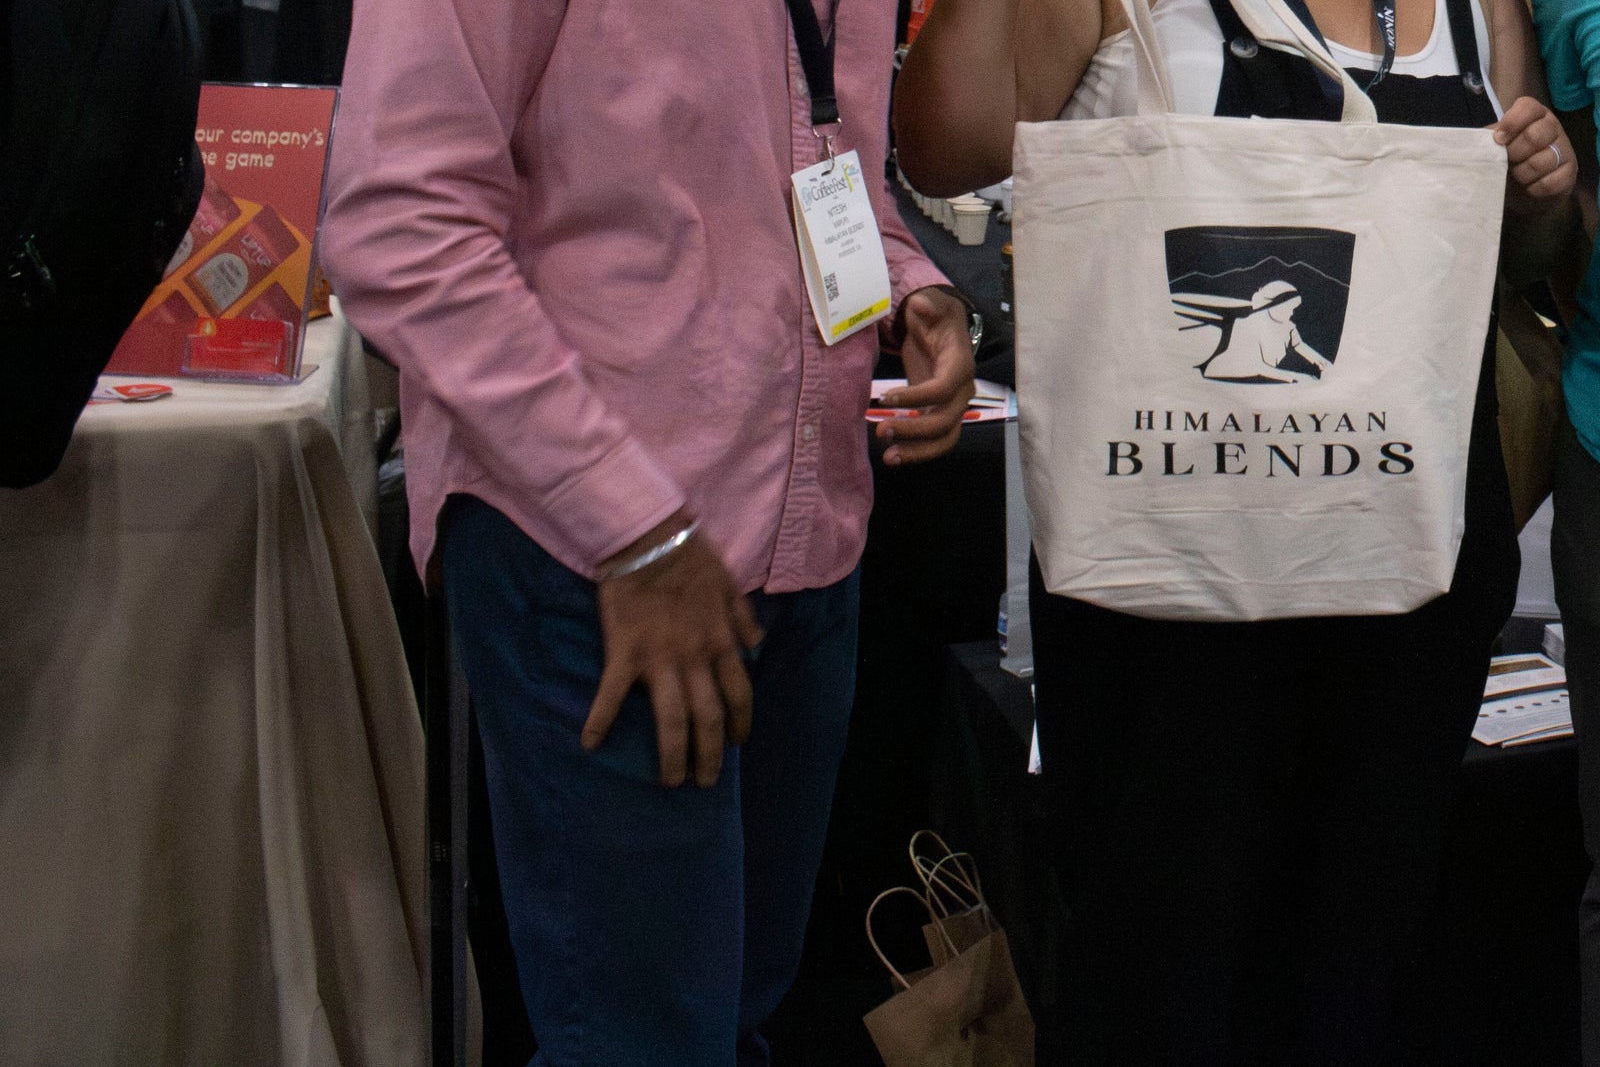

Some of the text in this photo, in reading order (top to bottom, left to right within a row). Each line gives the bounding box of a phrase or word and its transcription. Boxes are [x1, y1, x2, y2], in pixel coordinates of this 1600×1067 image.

[231, 128, 324, 149] company's
[225, 153, 274, 171] game
[1135, 409, 1387, 433] HIMALAYAN
[1105, 440, 1415, 478] BLENDS
